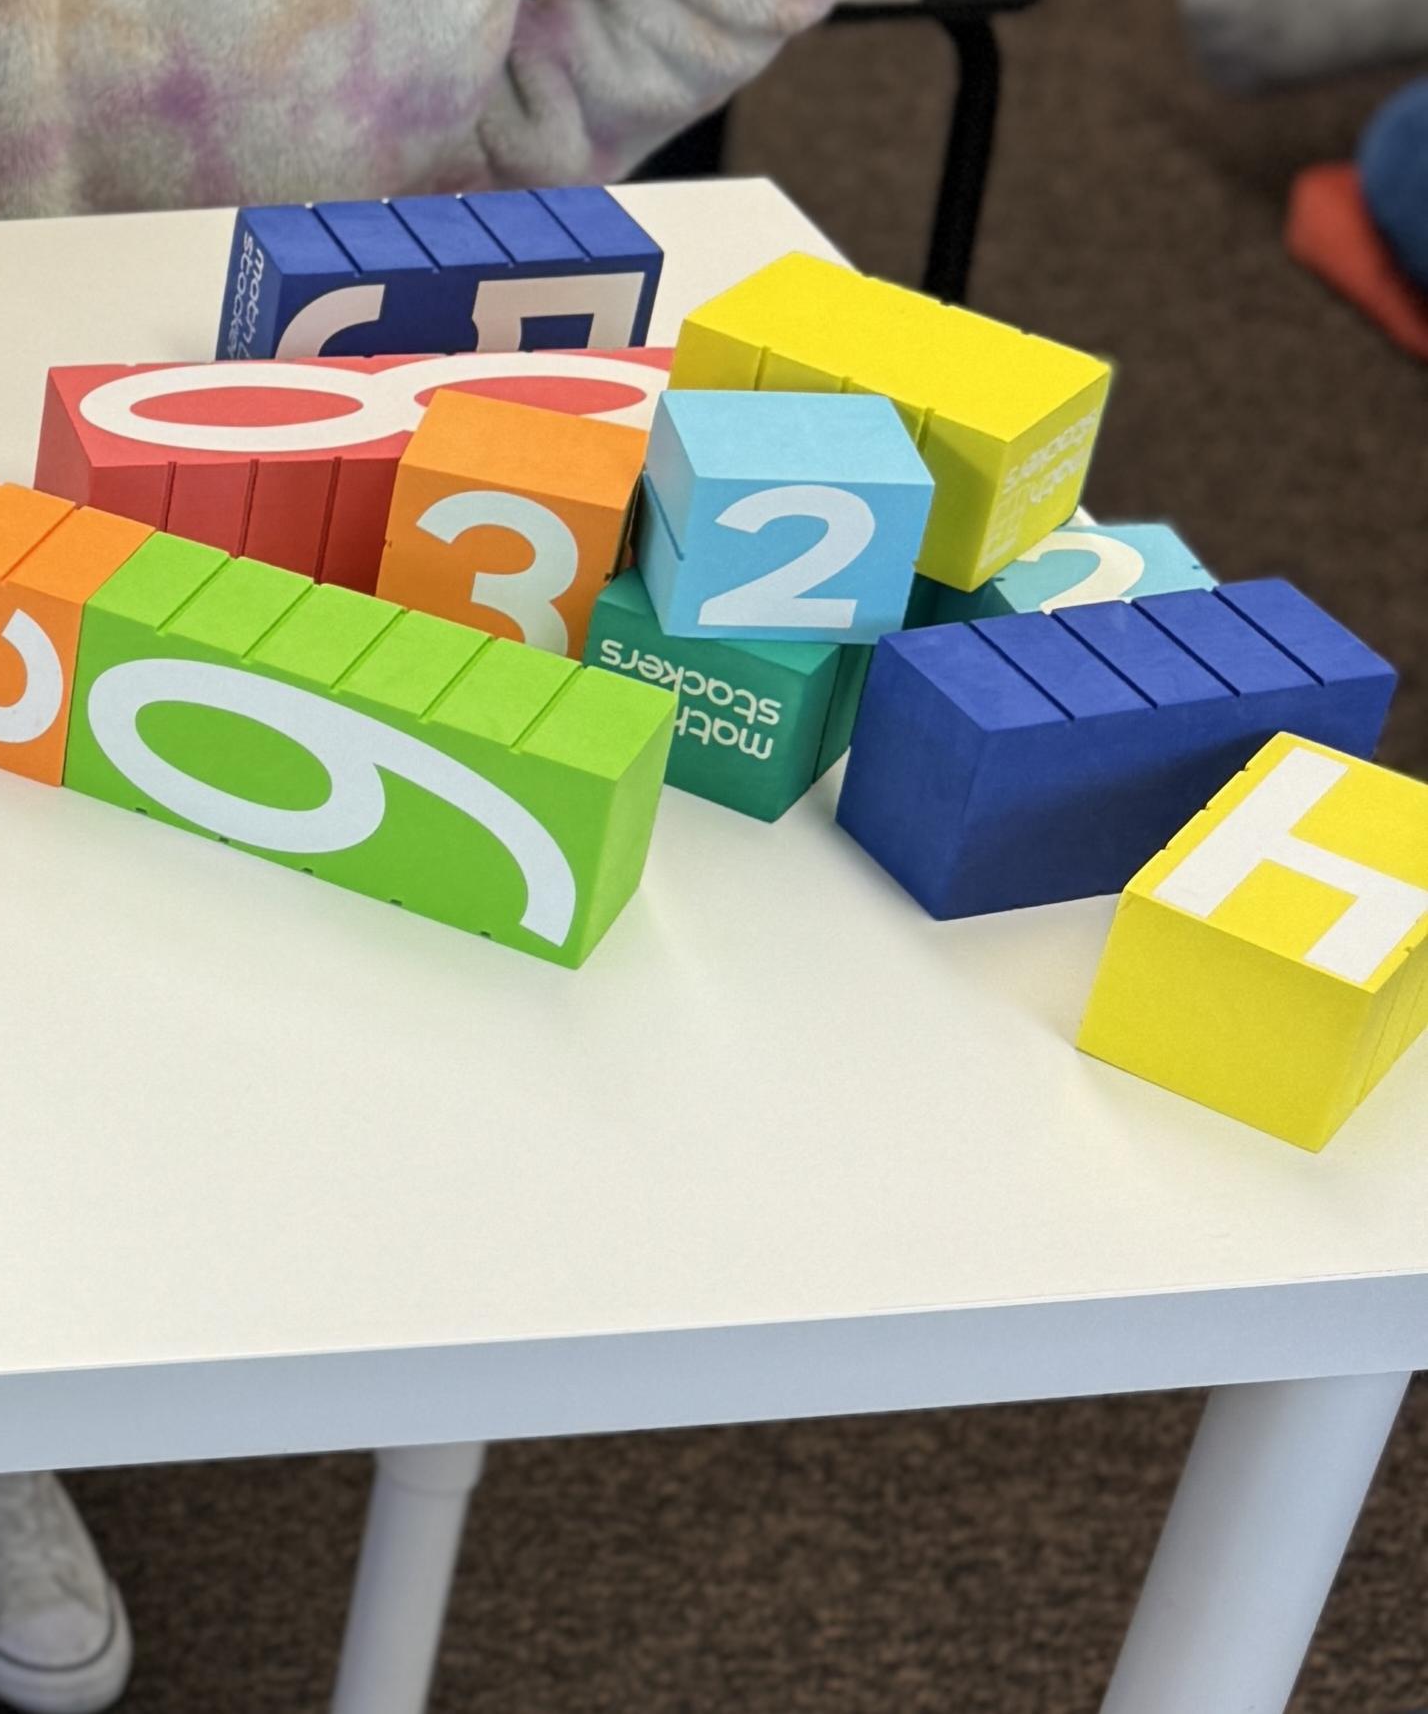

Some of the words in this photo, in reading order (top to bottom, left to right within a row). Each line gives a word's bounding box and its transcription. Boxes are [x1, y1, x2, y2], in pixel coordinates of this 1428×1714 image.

[228, 230, 253, 359] stacker
[79, 353, 670, 451] 8
[416, 490, 579, 655] 3
[698, 485, 875, 628] 2
[1015, 531, 1145, 613] 2
[601, 639, 781, 725] stackers
[1152, 746, 1428, 984] 4
